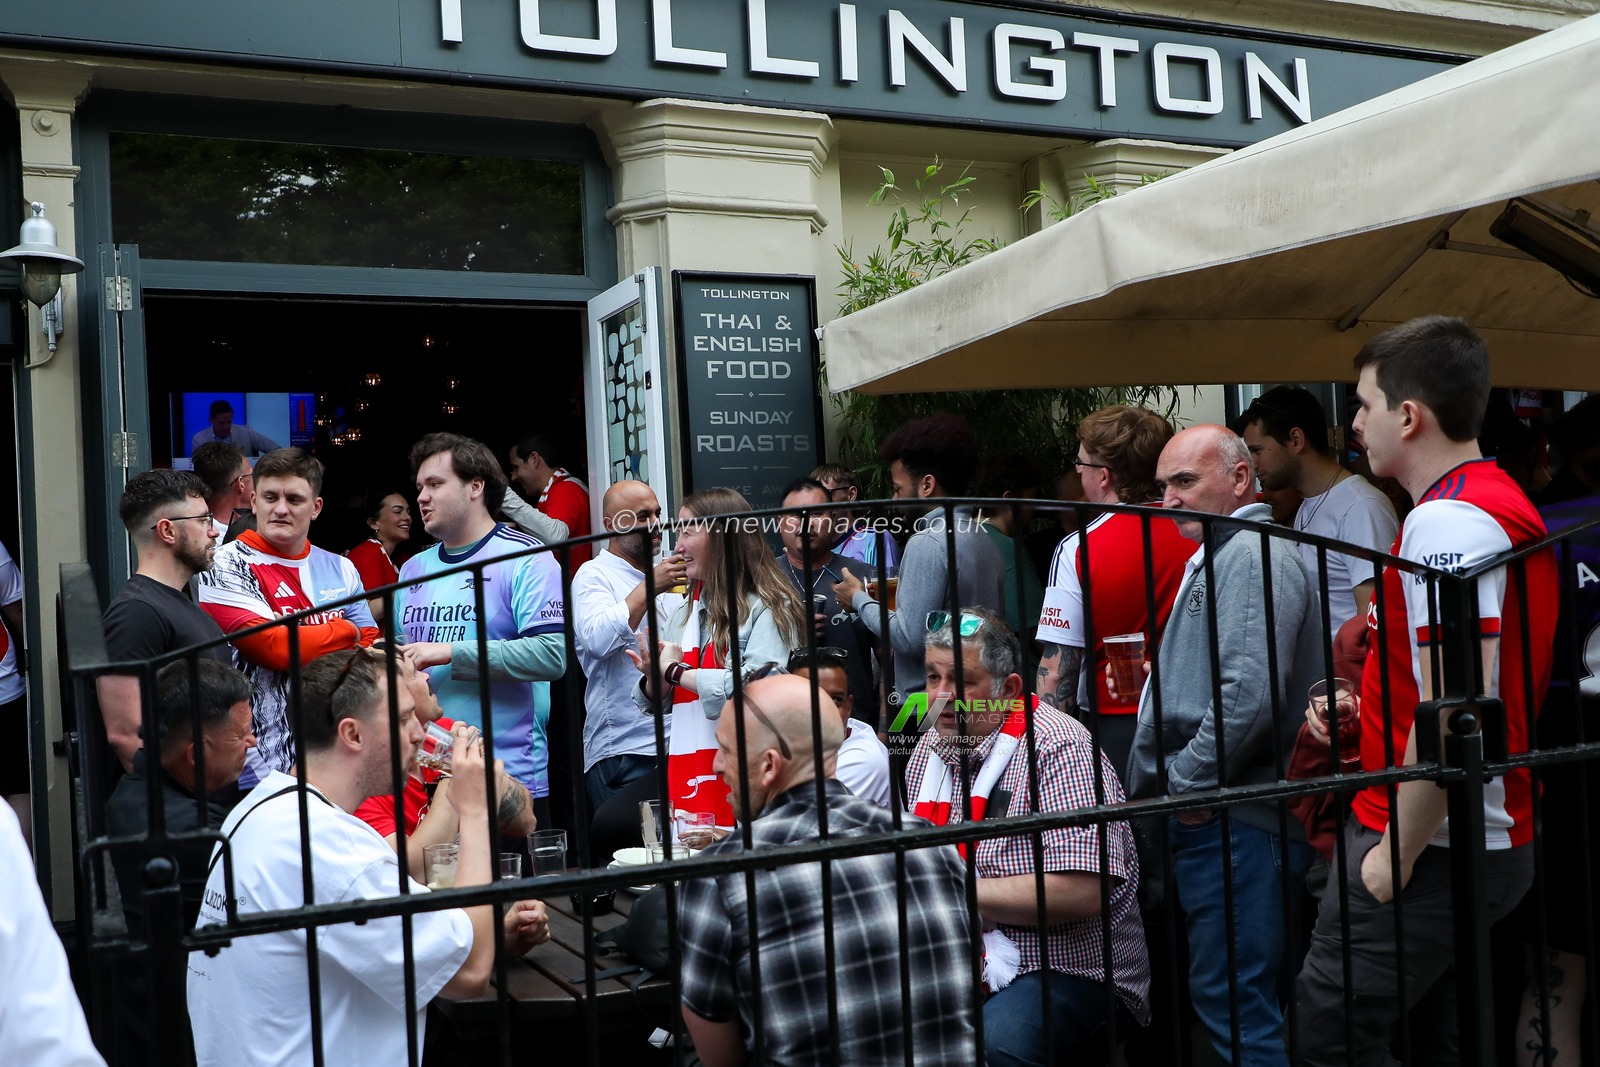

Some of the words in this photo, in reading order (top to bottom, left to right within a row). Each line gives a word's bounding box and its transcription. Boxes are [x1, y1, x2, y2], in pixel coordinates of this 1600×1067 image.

[700, 288, 790, 300] TOLLINGTON
[700, 313, 761, 330] THAI
[775, 315, 792, 331] &
[693, 335, 801, 353] ENGLISH
[707, 360, 791, 379] FOOD
[710, 411, 793, 425] SUNDAY
[697, 434, 810, 453] ROASTS
[1423, 553, 1464, 566] VISIT
[548, 601, 564, 609] VIS
[540, 610, 565, 619] RWA
[428, 626, 466, 643] BETTER
